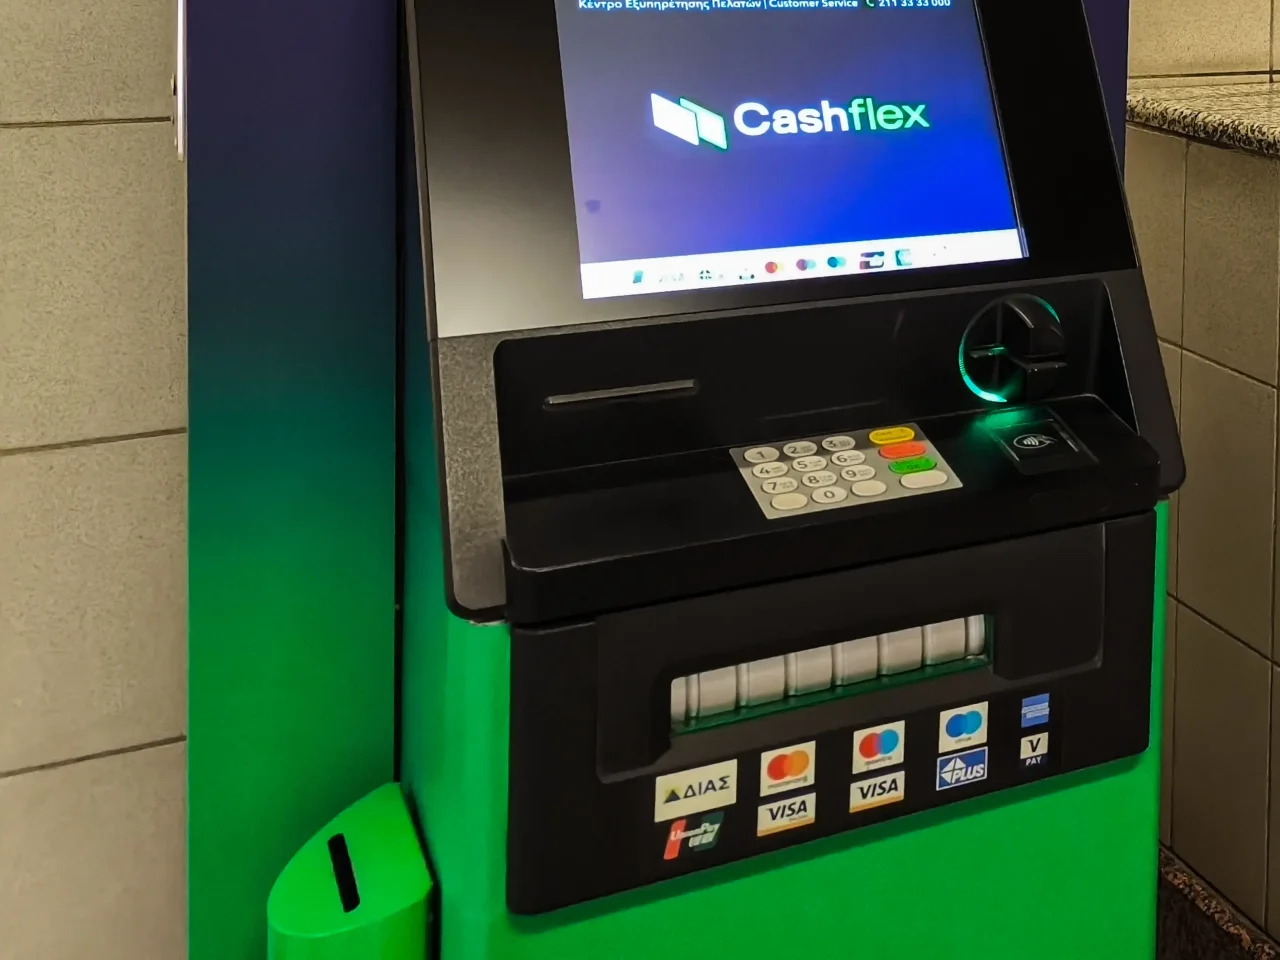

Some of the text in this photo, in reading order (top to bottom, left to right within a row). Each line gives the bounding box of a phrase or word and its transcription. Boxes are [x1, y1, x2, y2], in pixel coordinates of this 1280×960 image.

[733, 97, 930, 136] Cashflex
[825, 440, 836, 448] 3
[788, 446, 798, 454] 2
[756, 451, 765, 459] 1
[836, 454, 848, 463] 6
[797, 460, 808, 469] 5
[845, 469, 857, 478] 9
[808, 476, 819, 484] 8
[767, 481, 777, 490] 7
[824, 490, 835, 498] 0
[1028, 737, 1041, 753] V
[1026, 756, 1042, 766] PAY
[952, 764, 985, 784] PLUS
[683, 775, 731, 799] ΔΙΑΣ
[858, 778, 898, 800] VISA
[766, 800, 808, 821] VISA
